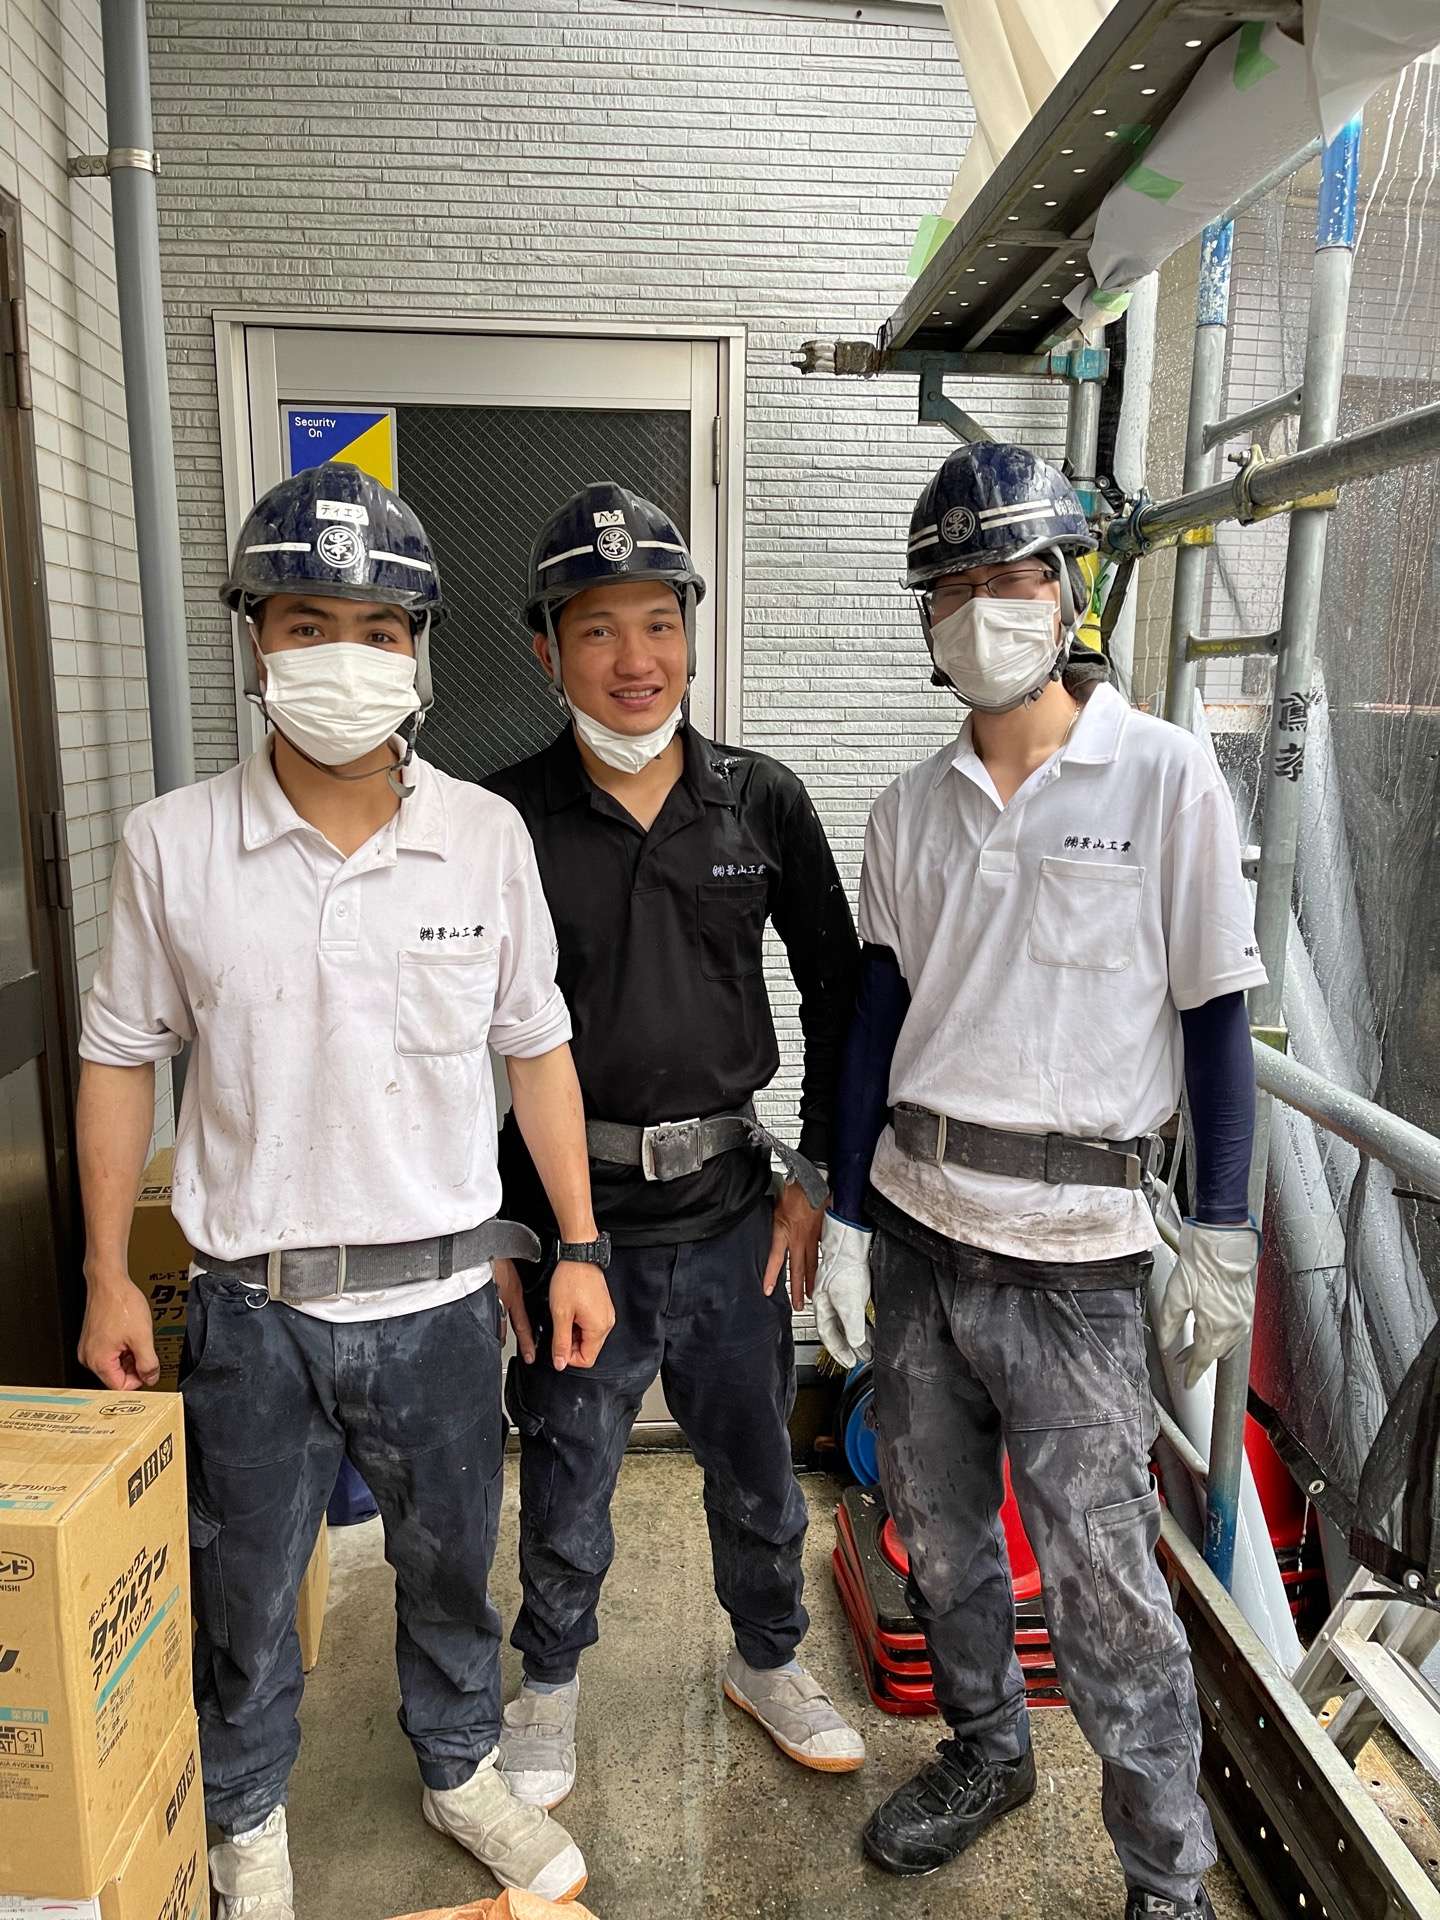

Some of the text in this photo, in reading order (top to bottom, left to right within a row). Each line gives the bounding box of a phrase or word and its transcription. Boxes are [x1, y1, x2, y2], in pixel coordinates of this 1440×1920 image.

[294, 416, 336, 428] Security
[308, 428, 323, 438] On
[90, 1543, 168, 1664] タイルワン
[17, 1730, 37, 1743] C1
